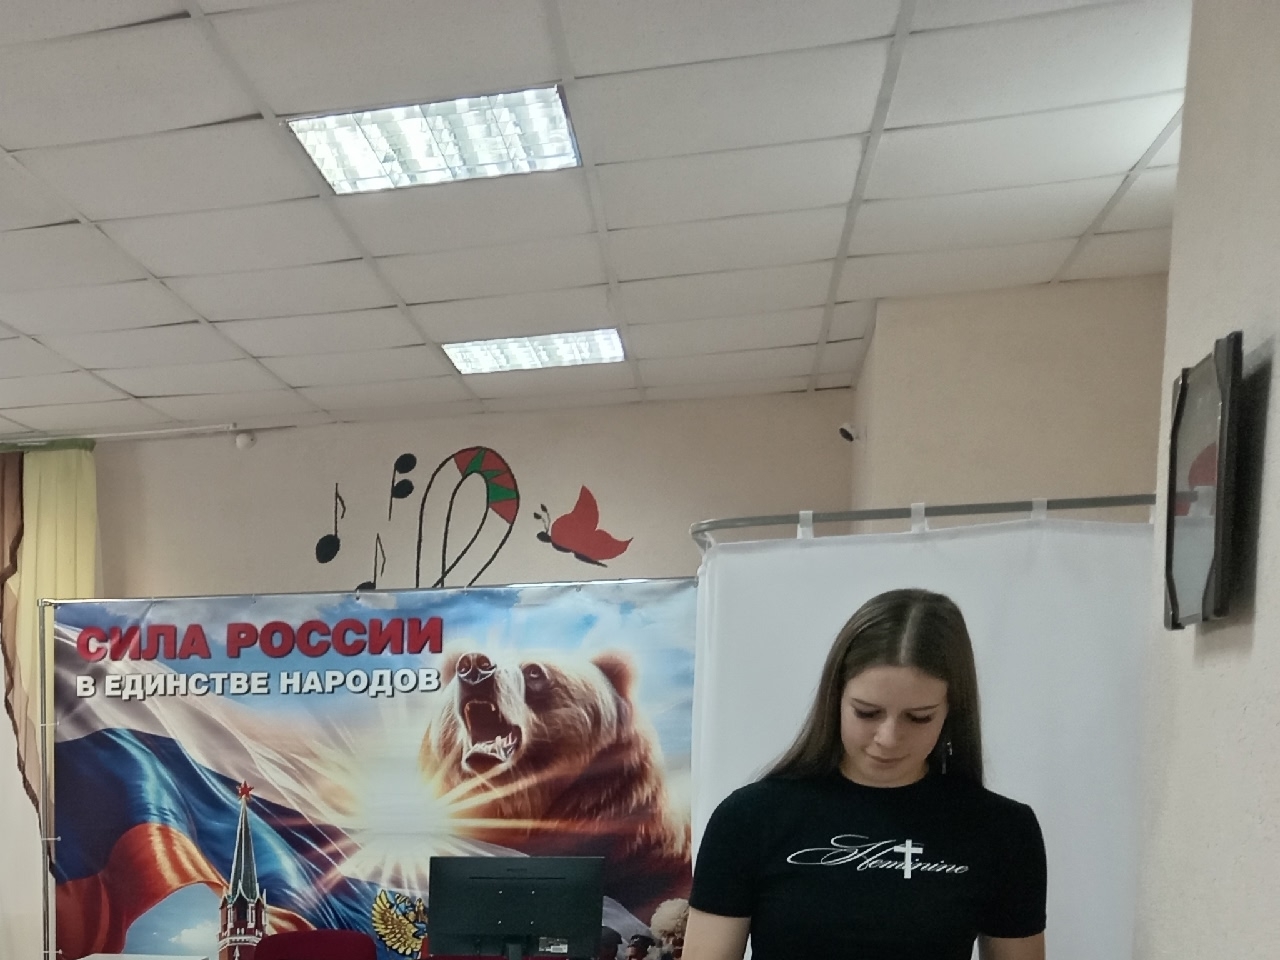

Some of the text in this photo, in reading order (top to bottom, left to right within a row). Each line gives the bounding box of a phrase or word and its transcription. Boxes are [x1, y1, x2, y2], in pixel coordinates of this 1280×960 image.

[76, 616, 443, 662] СИЛА РОССИИ
[76, 668, 441, 701] В ЕДИНСТВЕ НАРОДОВ
